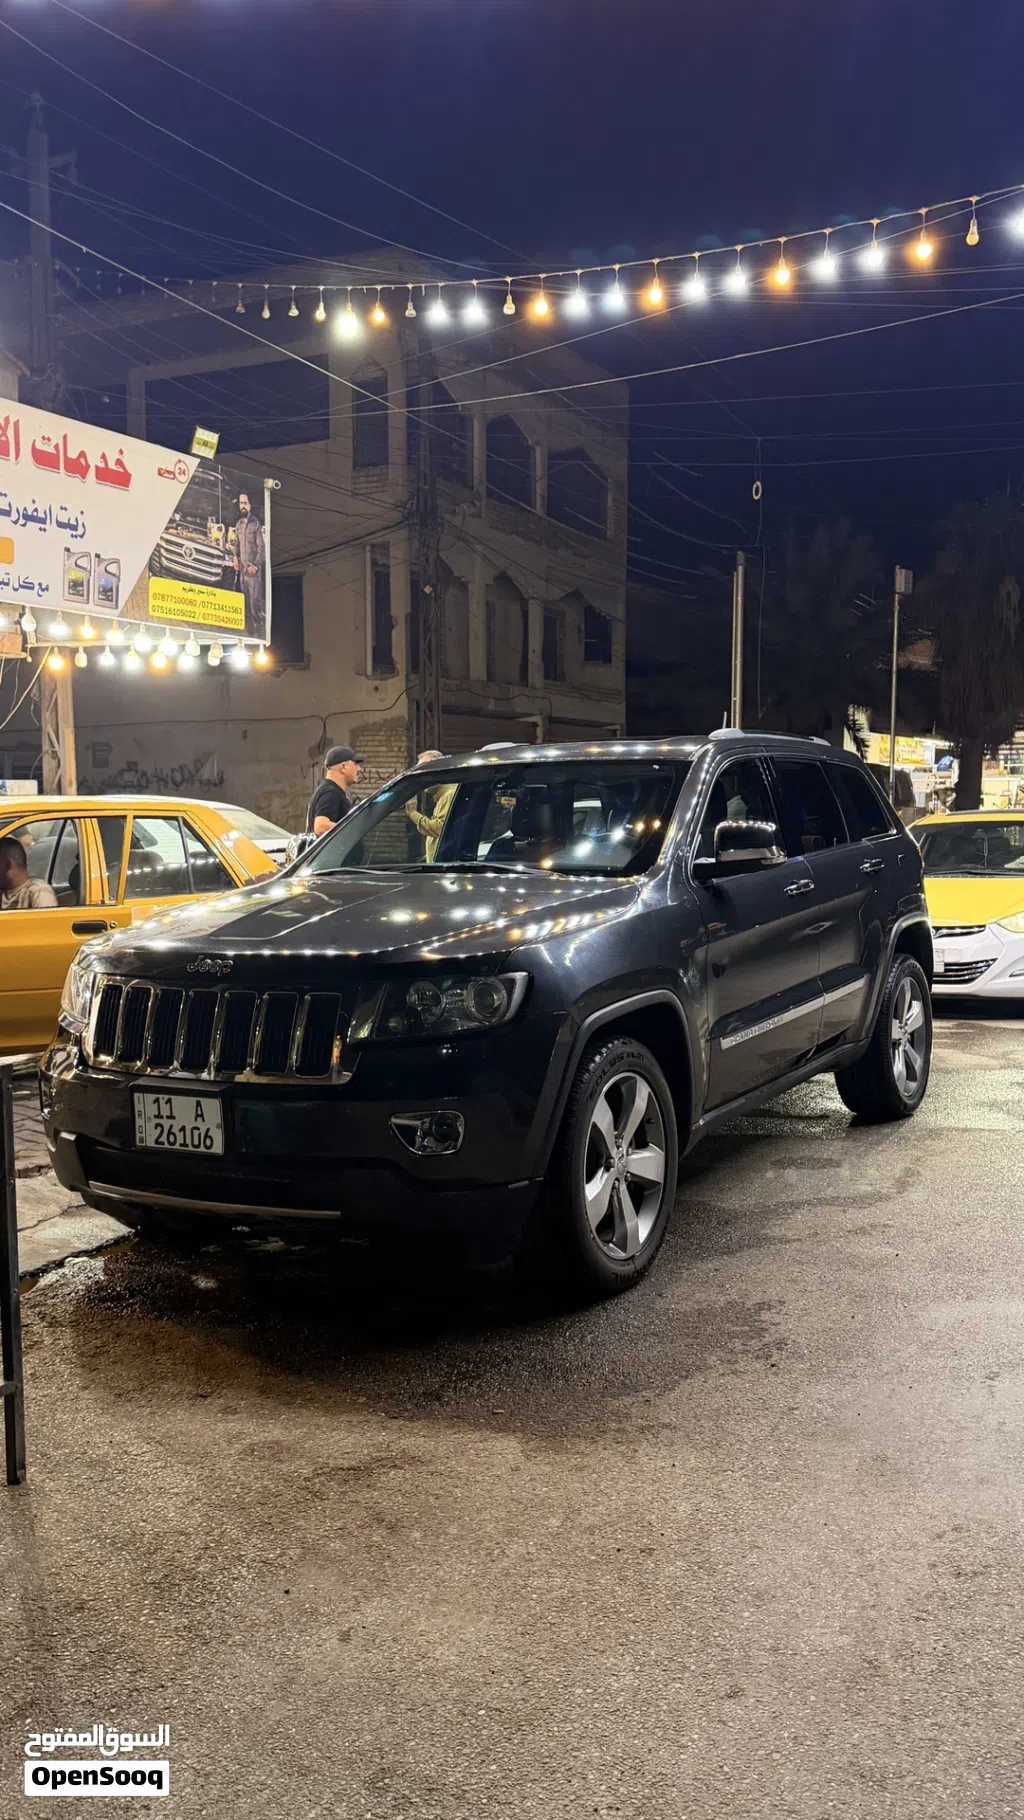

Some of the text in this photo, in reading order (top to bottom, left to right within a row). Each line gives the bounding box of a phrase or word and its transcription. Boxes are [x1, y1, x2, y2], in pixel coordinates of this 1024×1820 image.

[31, 433, 132, 488] خدمات
[178, 467, 186, 476] 24
[56, 505, 86, 539] زيت
[12, 574, 35, 592] كل
[37, 582, 49, 597] مع
[152, 605, 196, 618] 07516105022
[187, 955, 233, 976] Jeep
[153, 1097, 205, 1122] 11 A
[154, 1123, 214, 1150] 26106
